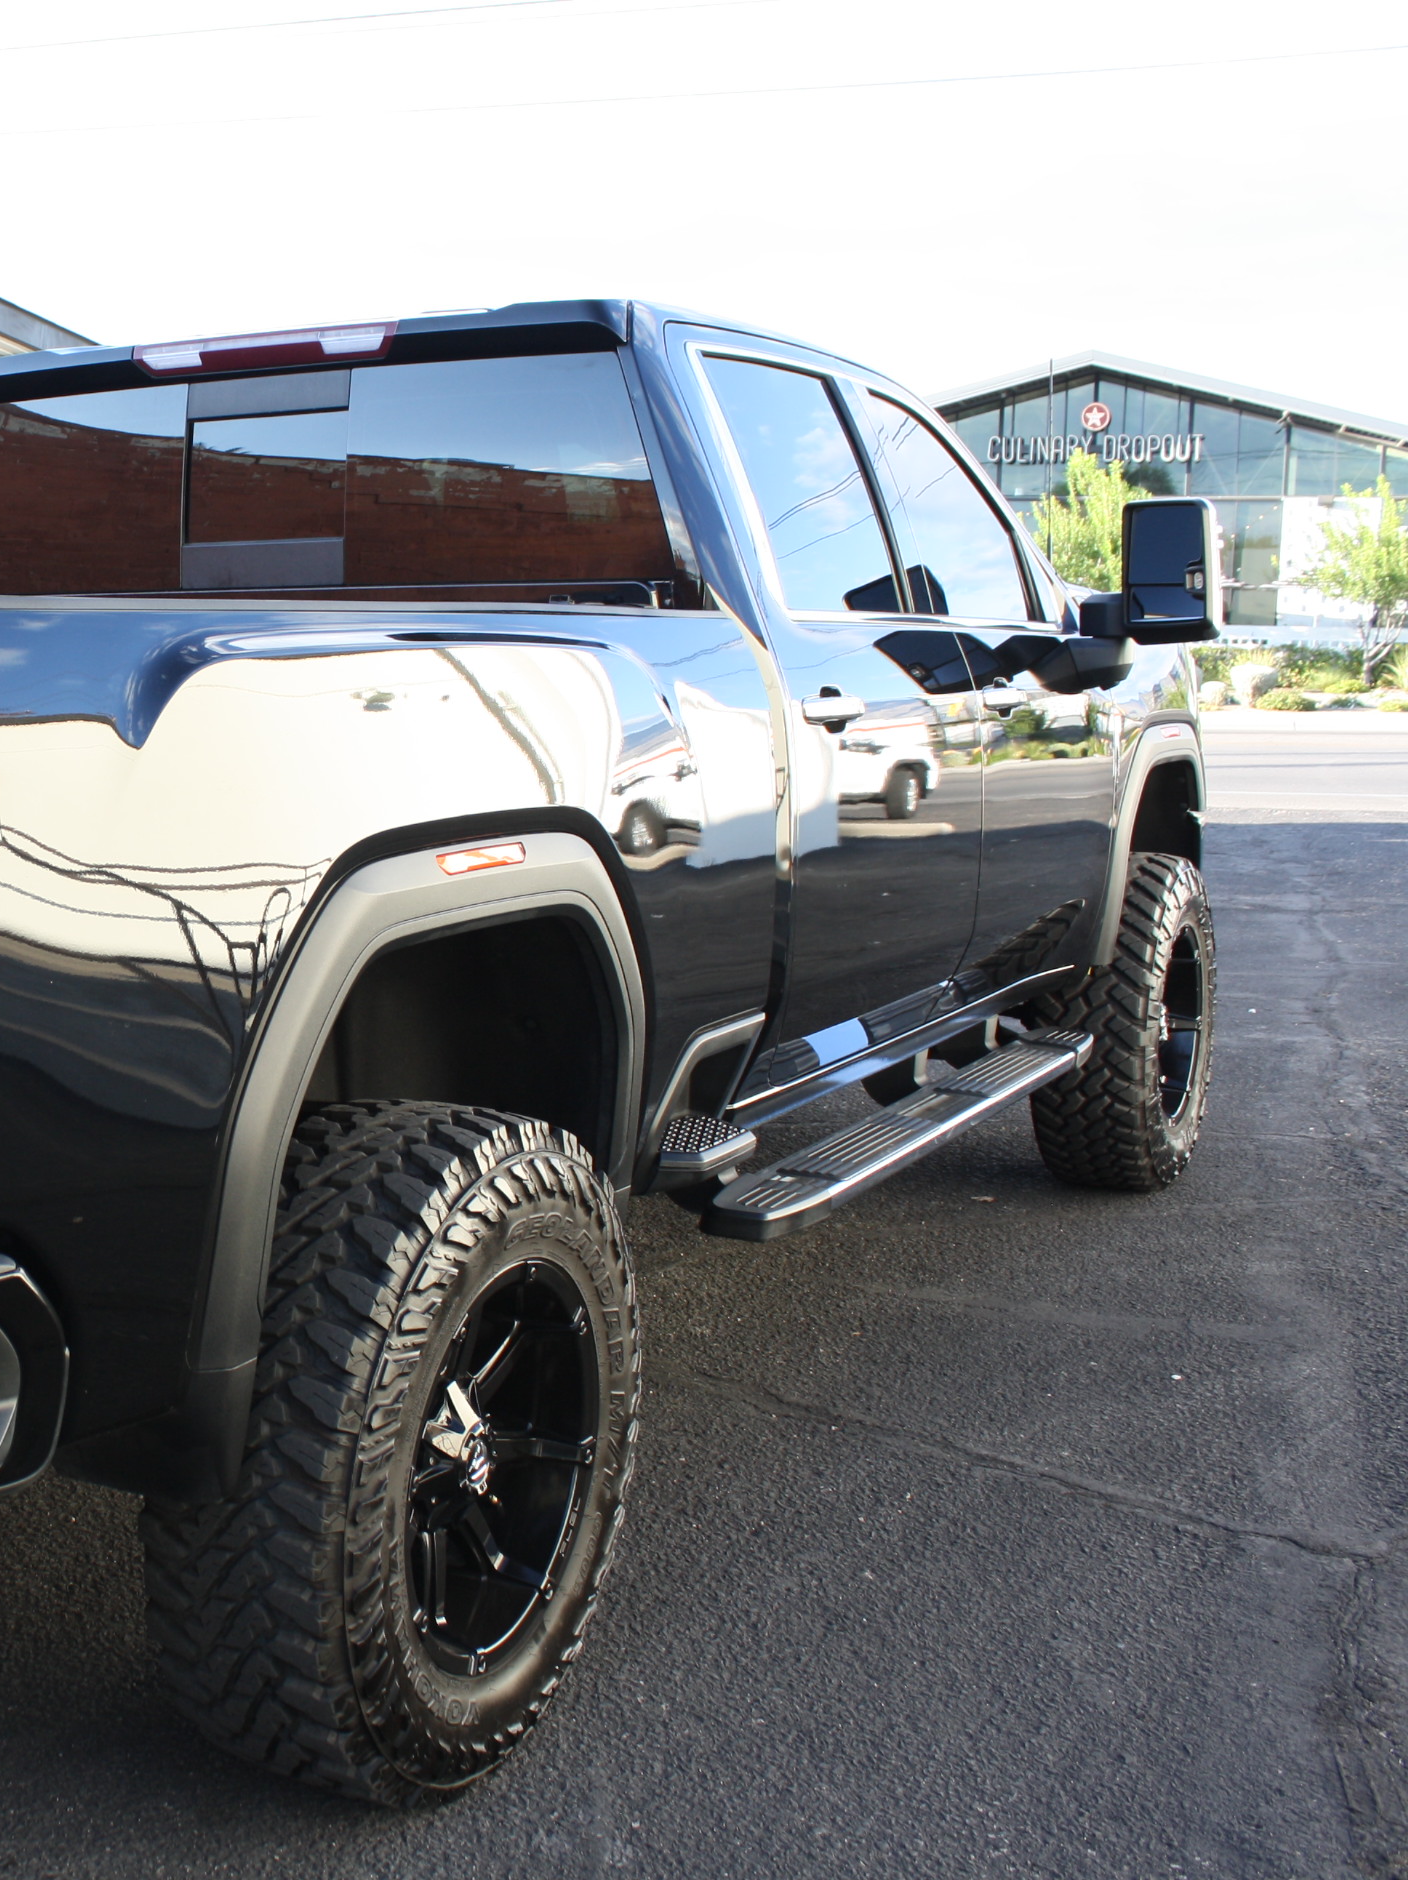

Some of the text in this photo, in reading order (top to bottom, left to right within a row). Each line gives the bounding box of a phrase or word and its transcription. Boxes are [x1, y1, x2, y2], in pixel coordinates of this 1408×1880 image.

[987, 434, 1205, 464] CULINARY DROPOUT
[504, 1211, 625, 1375] GEOLANDAR
